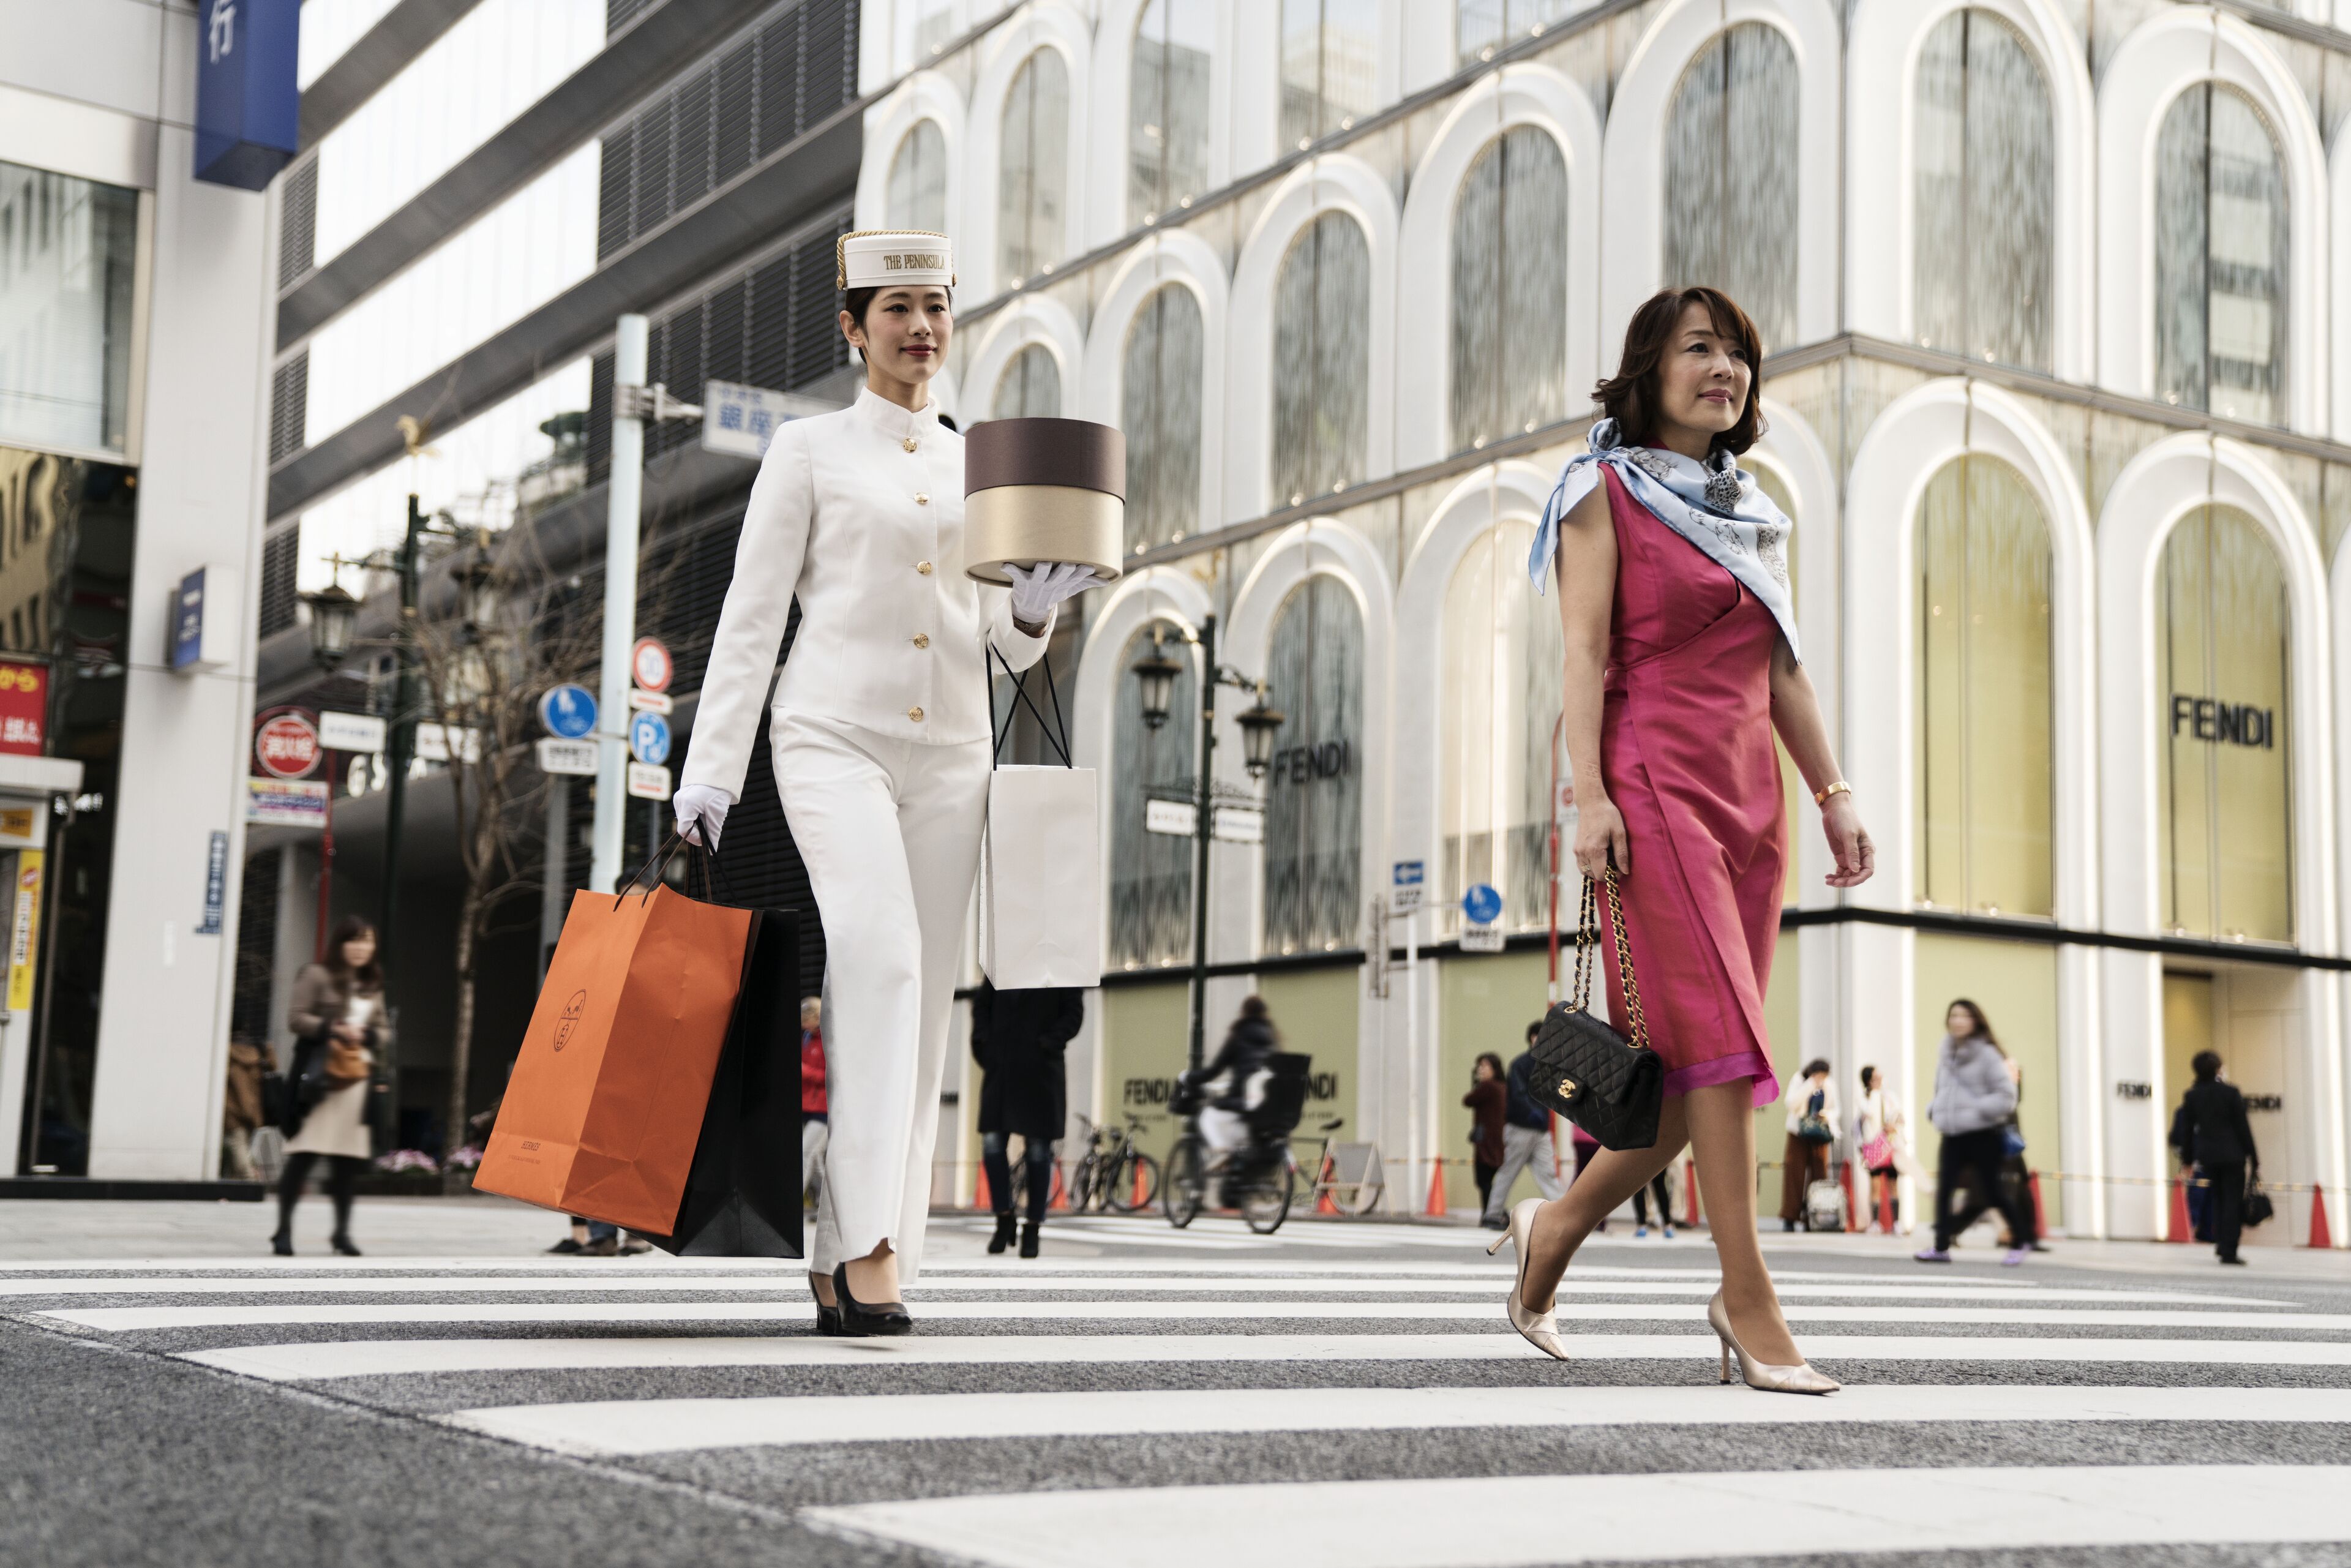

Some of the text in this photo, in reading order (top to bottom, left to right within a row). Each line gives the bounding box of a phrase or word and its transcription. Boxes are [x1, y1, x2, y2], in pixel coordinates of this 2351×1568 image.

[883, 254, 945, 270] THE PENINSULA
[2170, 694, 2273, 751] FENDI
[1273, 739, 1350, 787] FENDI
[1124, 1079, 1169, 1105] FENDI
[1305, 1072, 1337, 1100] NDI
